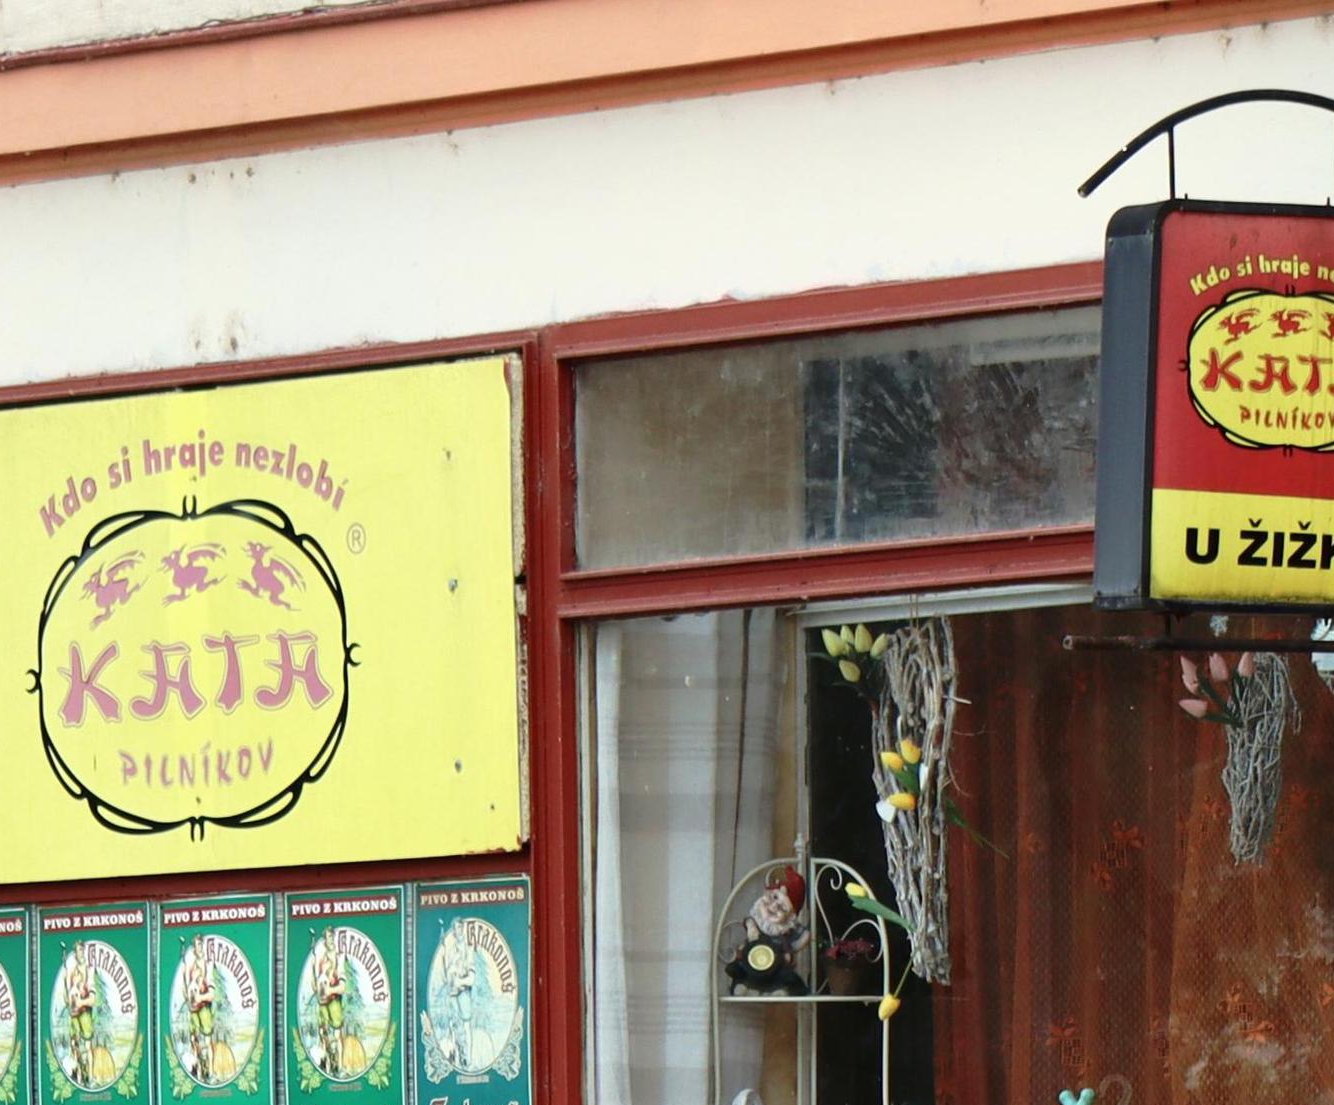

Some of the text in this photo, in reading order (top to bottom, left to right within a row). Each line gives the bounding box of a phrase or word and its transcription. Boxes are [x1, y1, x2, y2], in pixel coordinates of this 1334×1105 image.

[1190, 264, 1230, 296] Kdo
[1237, 255, 1252, 278] si
[1259, 254, 1311, 280] hraje
[39, 429, 351, 539] Kdo si hraje nezlobí
[1185, 527, 1220, 564] U
[57, 628, 335, 728] KATA
[117, 739, 276, 789] PILNÍKOV
[164, 906, 266, 924] PIVO Z KRKONOŠ
[292, 898, 397, 915] PIVO Z KRKONOŠ
[421, 888, 524, 905] PIVO Z KRKONOŠ
[44, 910, 143, 930] PIVO Z KRKONOŠ
